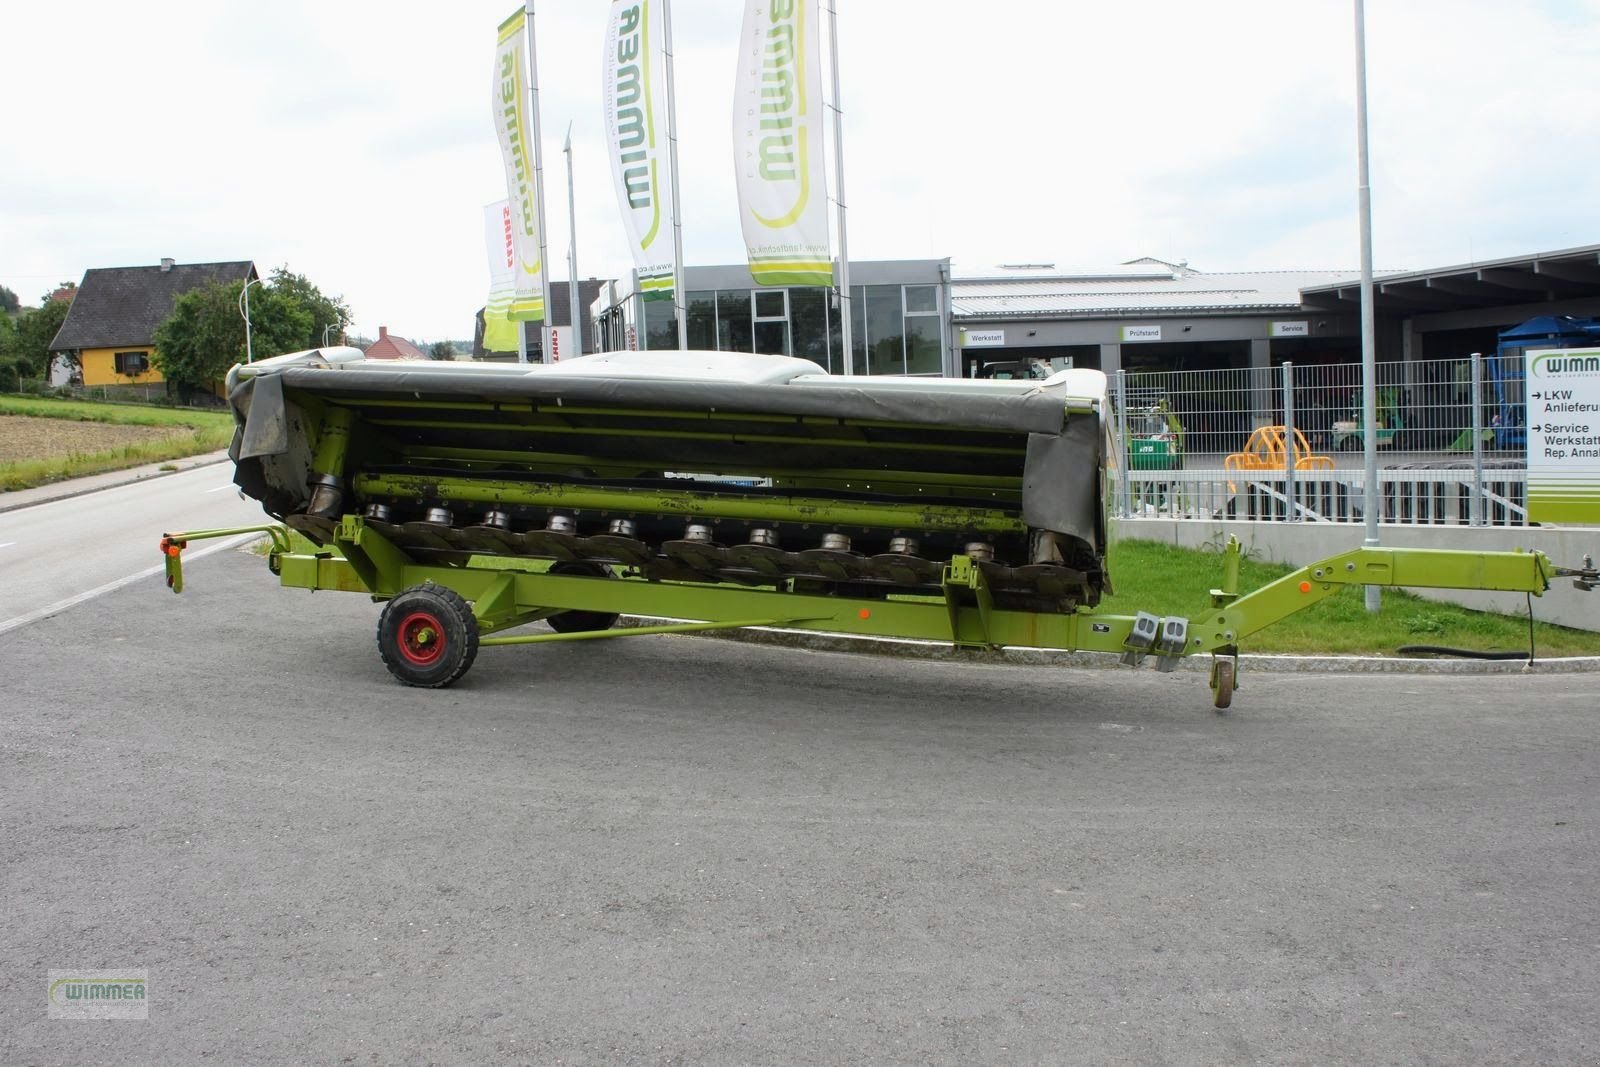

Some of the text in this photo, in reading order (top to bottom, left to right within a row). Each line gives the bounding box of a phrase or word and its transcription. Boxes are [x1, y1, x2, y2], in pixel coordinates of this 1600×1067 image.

[1547, 357, 1600, 373] WIMM
[1544, 390, 1573, 400] LKW
[1544, 402, 1600, 412] Anlieferu
[1544, 423, 1589, 433] Service
[1544, 448, 1568, 459] Rep.
